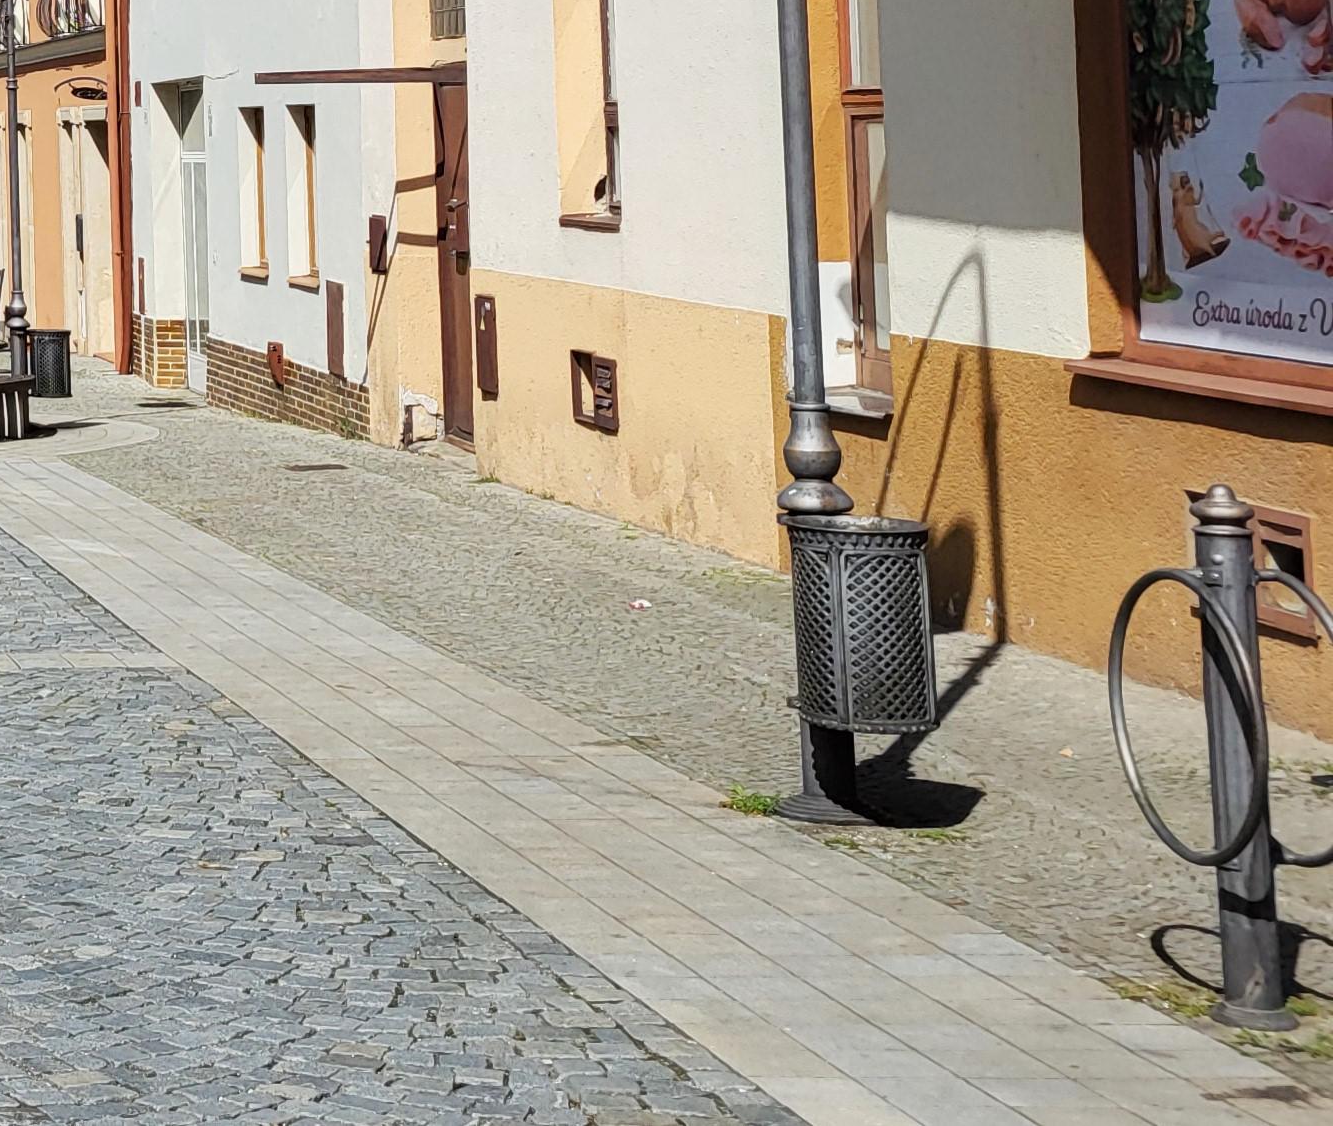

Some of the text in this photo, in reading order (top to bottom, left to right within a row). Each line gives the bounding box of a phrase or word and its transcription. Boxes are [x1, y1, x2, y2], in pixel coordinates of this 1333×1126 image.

[1192, 290, 1242, 327] Extra
[1245, 298, 1294, 331] úroda
[1298, 313, 1309, 333] z
